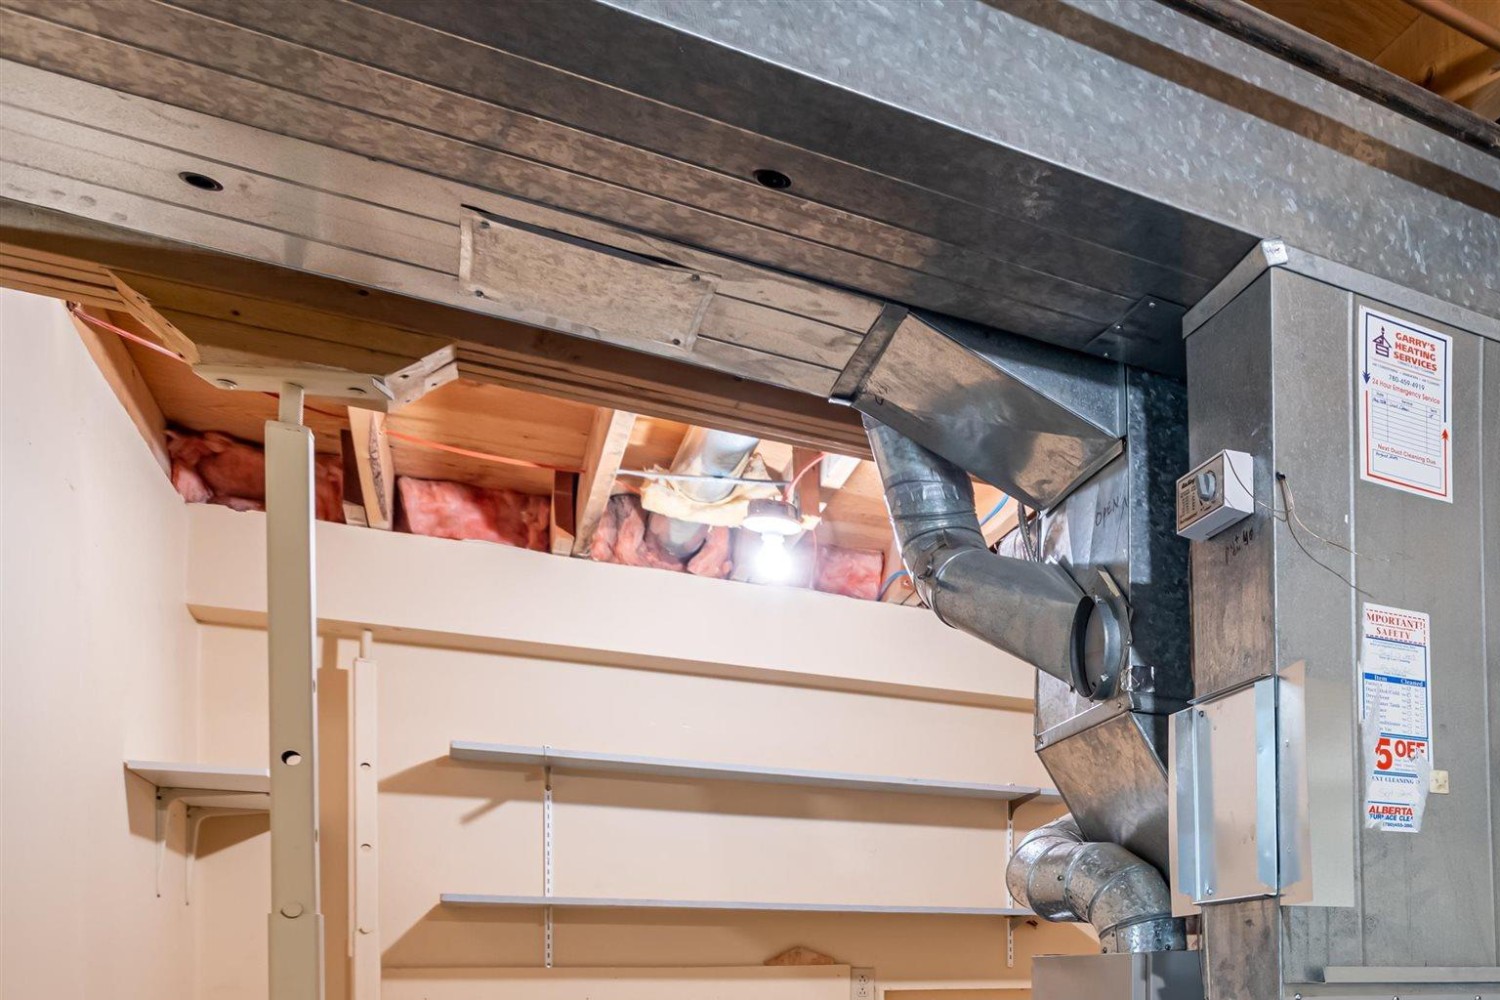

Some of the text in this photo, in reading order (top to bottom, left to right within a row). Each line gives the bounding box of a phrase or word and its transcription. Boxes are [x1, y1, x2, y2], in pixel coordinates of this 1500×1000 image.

[1394, 342, 1436, 362] HEATING
[1395, 332, 1436, 352] GARRY'S
[1393, 351, 1438, 372] SERVICES
[1372, 377, 1379, 386] 24
[1379, 379, 1392, 390] Hour
[1392, 383, 1421, 399] Emergency
[1422, 393, 1441, 405] Service
[1377, 443, 1389, 451] Next
[1390, 447, 1402, 455] Duct
[1402, 450, 1426, 463] Cleaning
[1426, 457, 1437, 465] Due
[1366, 612, 1424, 630] MPORTANT!
[1376, 626, 1411, 640] SAFETY
[1400, 676, 1424, 687] Cleaned
[1375, 737, 1393, 771] 5
[1368, 804, 1413, 816] ALBERTA
